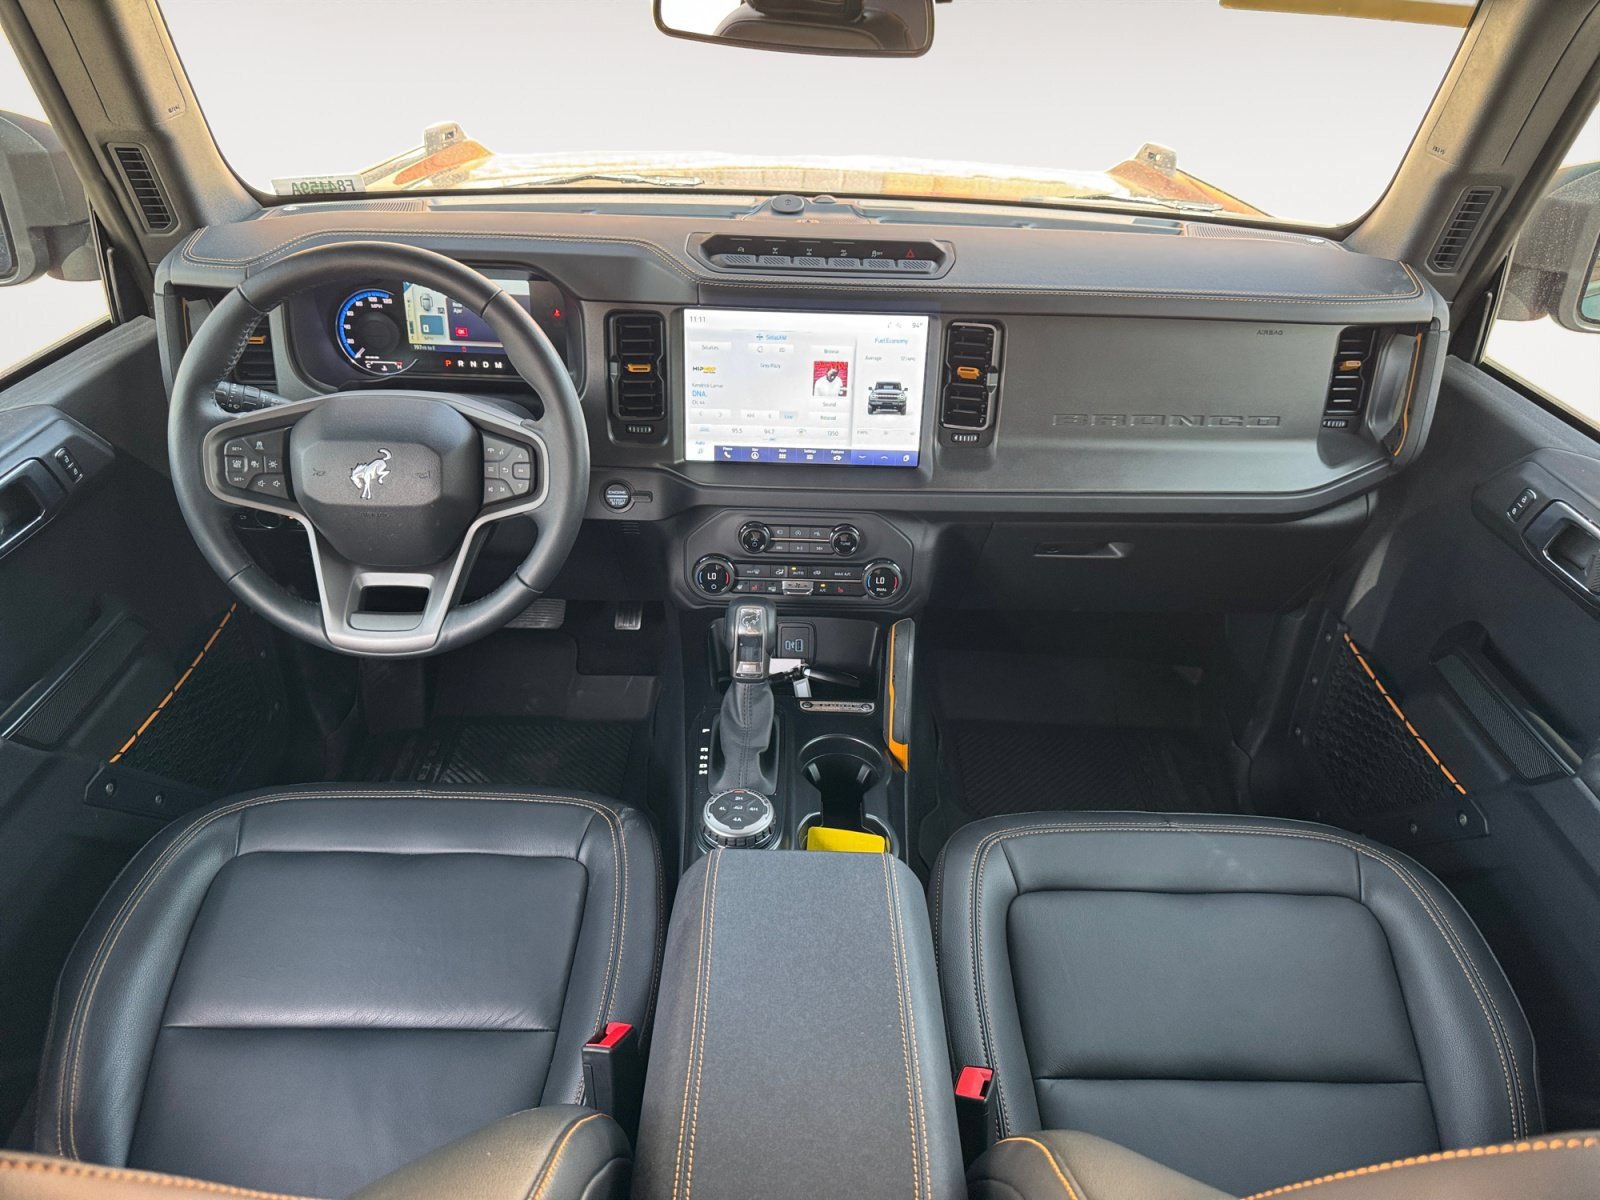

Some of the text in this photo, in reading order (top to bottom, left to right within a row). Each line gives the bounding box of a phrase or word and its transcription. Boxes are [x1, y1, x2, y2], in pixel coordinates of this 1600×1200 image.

[494, 361, 503, 369] M
[1051, 413, 1281, 428] BRONCO
[707, 572, 717, 580] LO
[875, 576, 885, 585] LO
